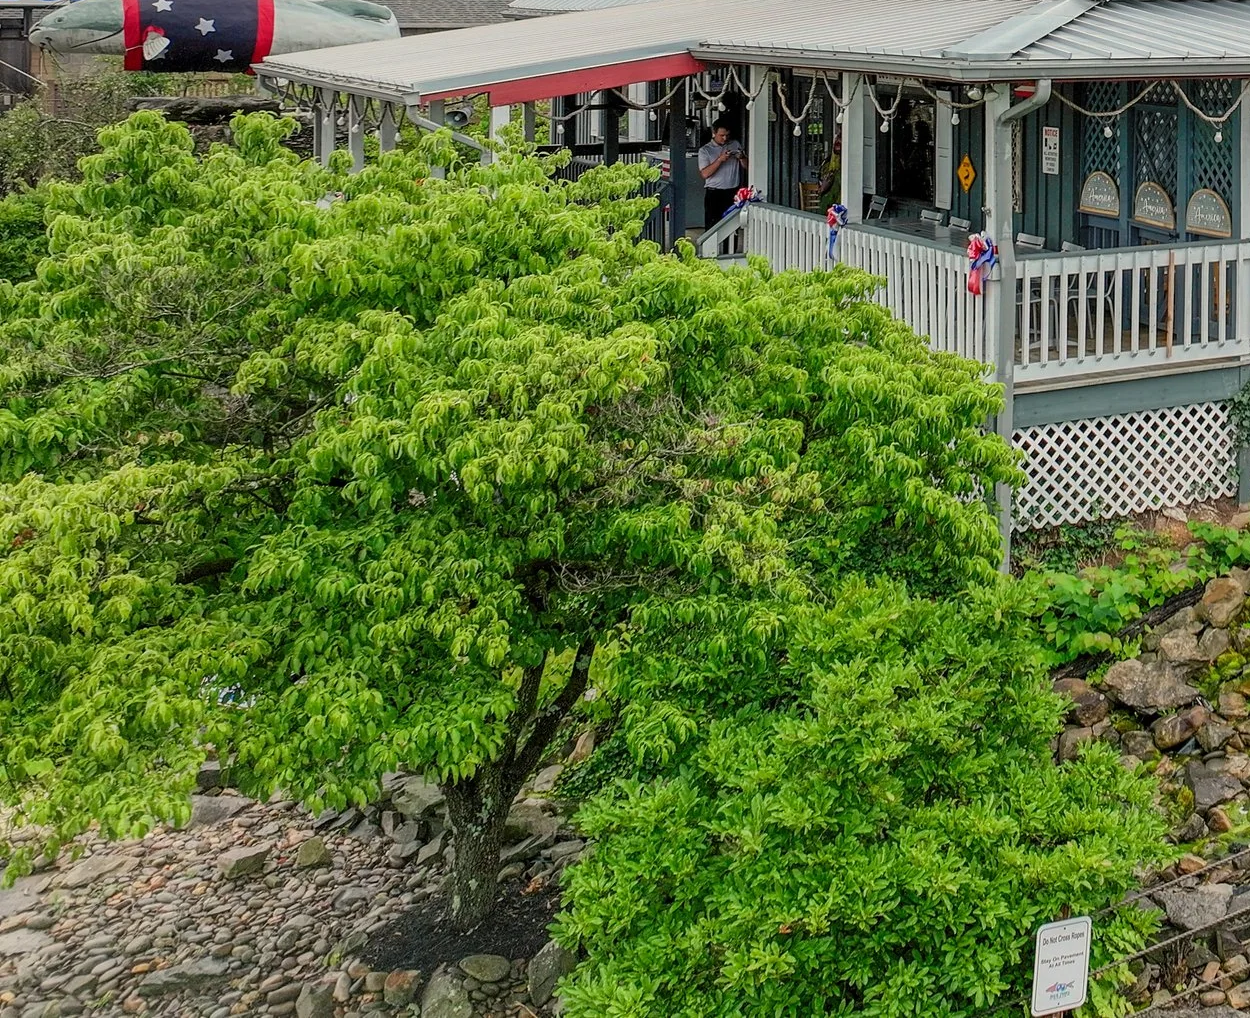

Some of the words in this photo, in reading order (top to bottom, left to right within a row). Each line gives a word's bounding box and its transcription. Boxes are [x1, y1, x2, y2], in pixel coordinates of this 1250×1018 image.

[1044, 128, 1058, 138] NOTICE
[1043, 938, 1049, 946] Do
[1050, 936, 1058, 944] Not
[1058, 934, 1070, 943] Cross
[1071, 932, 1085, 940] Ropes
[1061, 951, 1083, 960] Pavement
